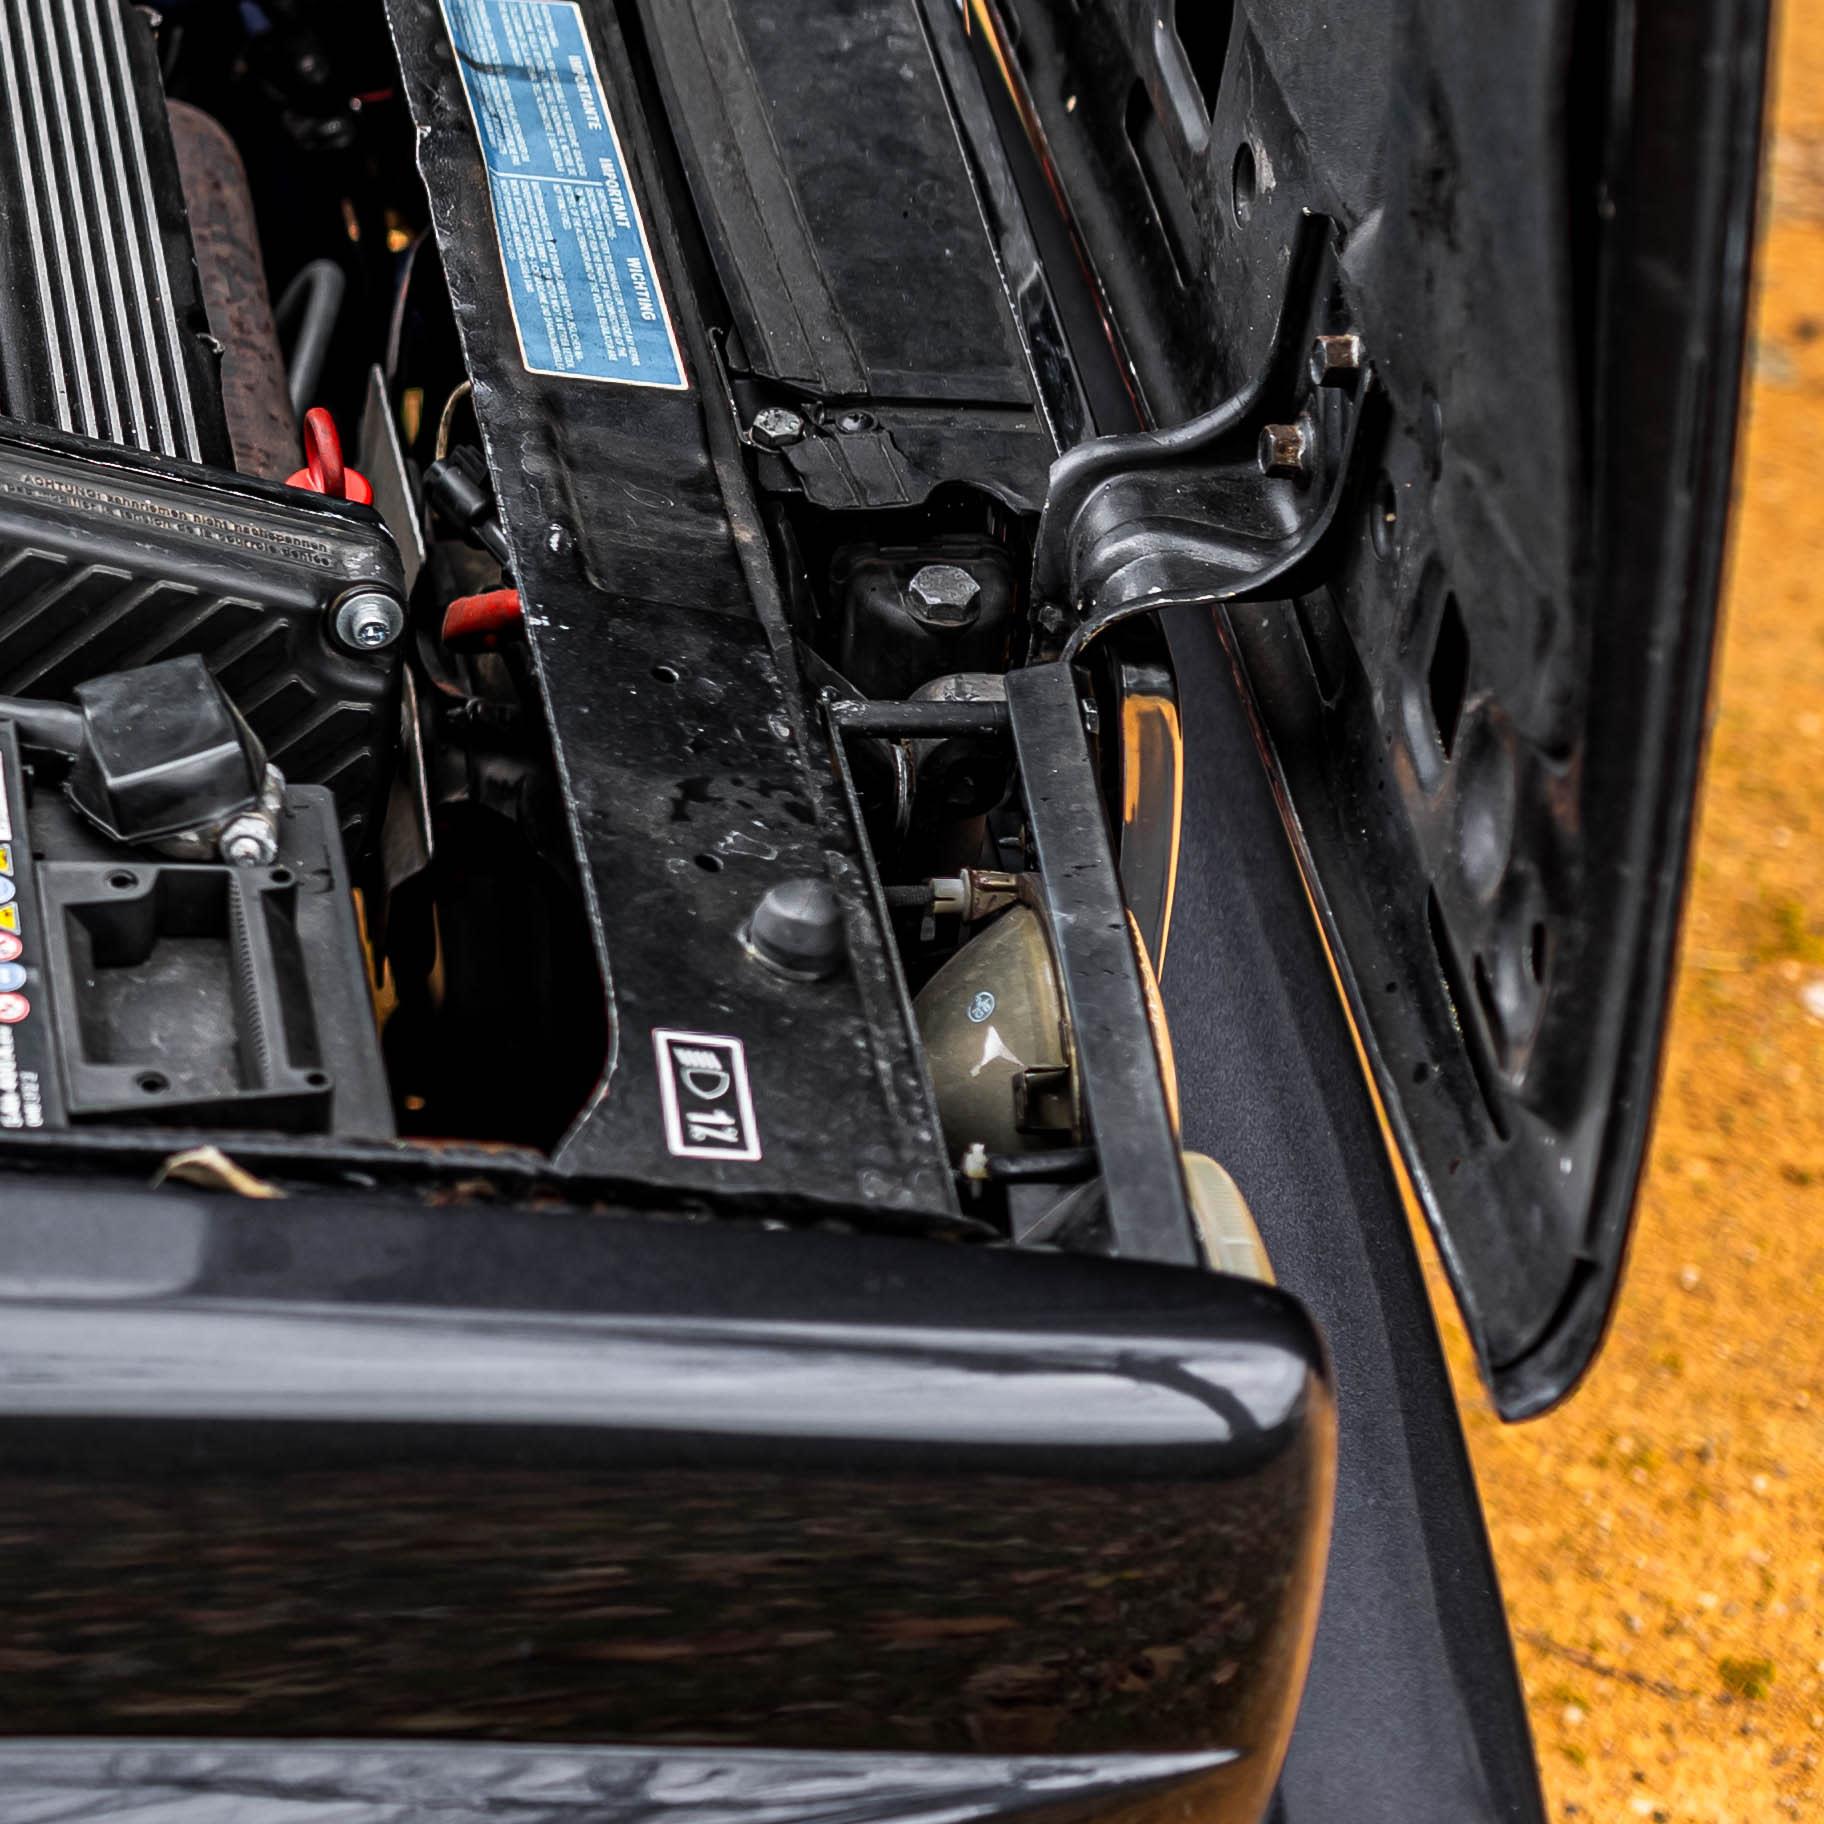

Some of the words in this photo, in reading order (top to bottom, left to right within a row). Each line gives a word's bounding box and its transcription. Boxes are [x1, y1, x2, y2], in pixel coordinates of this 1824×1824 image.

[567, 54, 602, 131] IMPORTANTE
[599, 156, 631, 229] IMPORTANT
[626, 256, 658, 322] WICHTING
[193, 510, 229, 532] nicht
[232, 516, 328, 554] nachspannen
